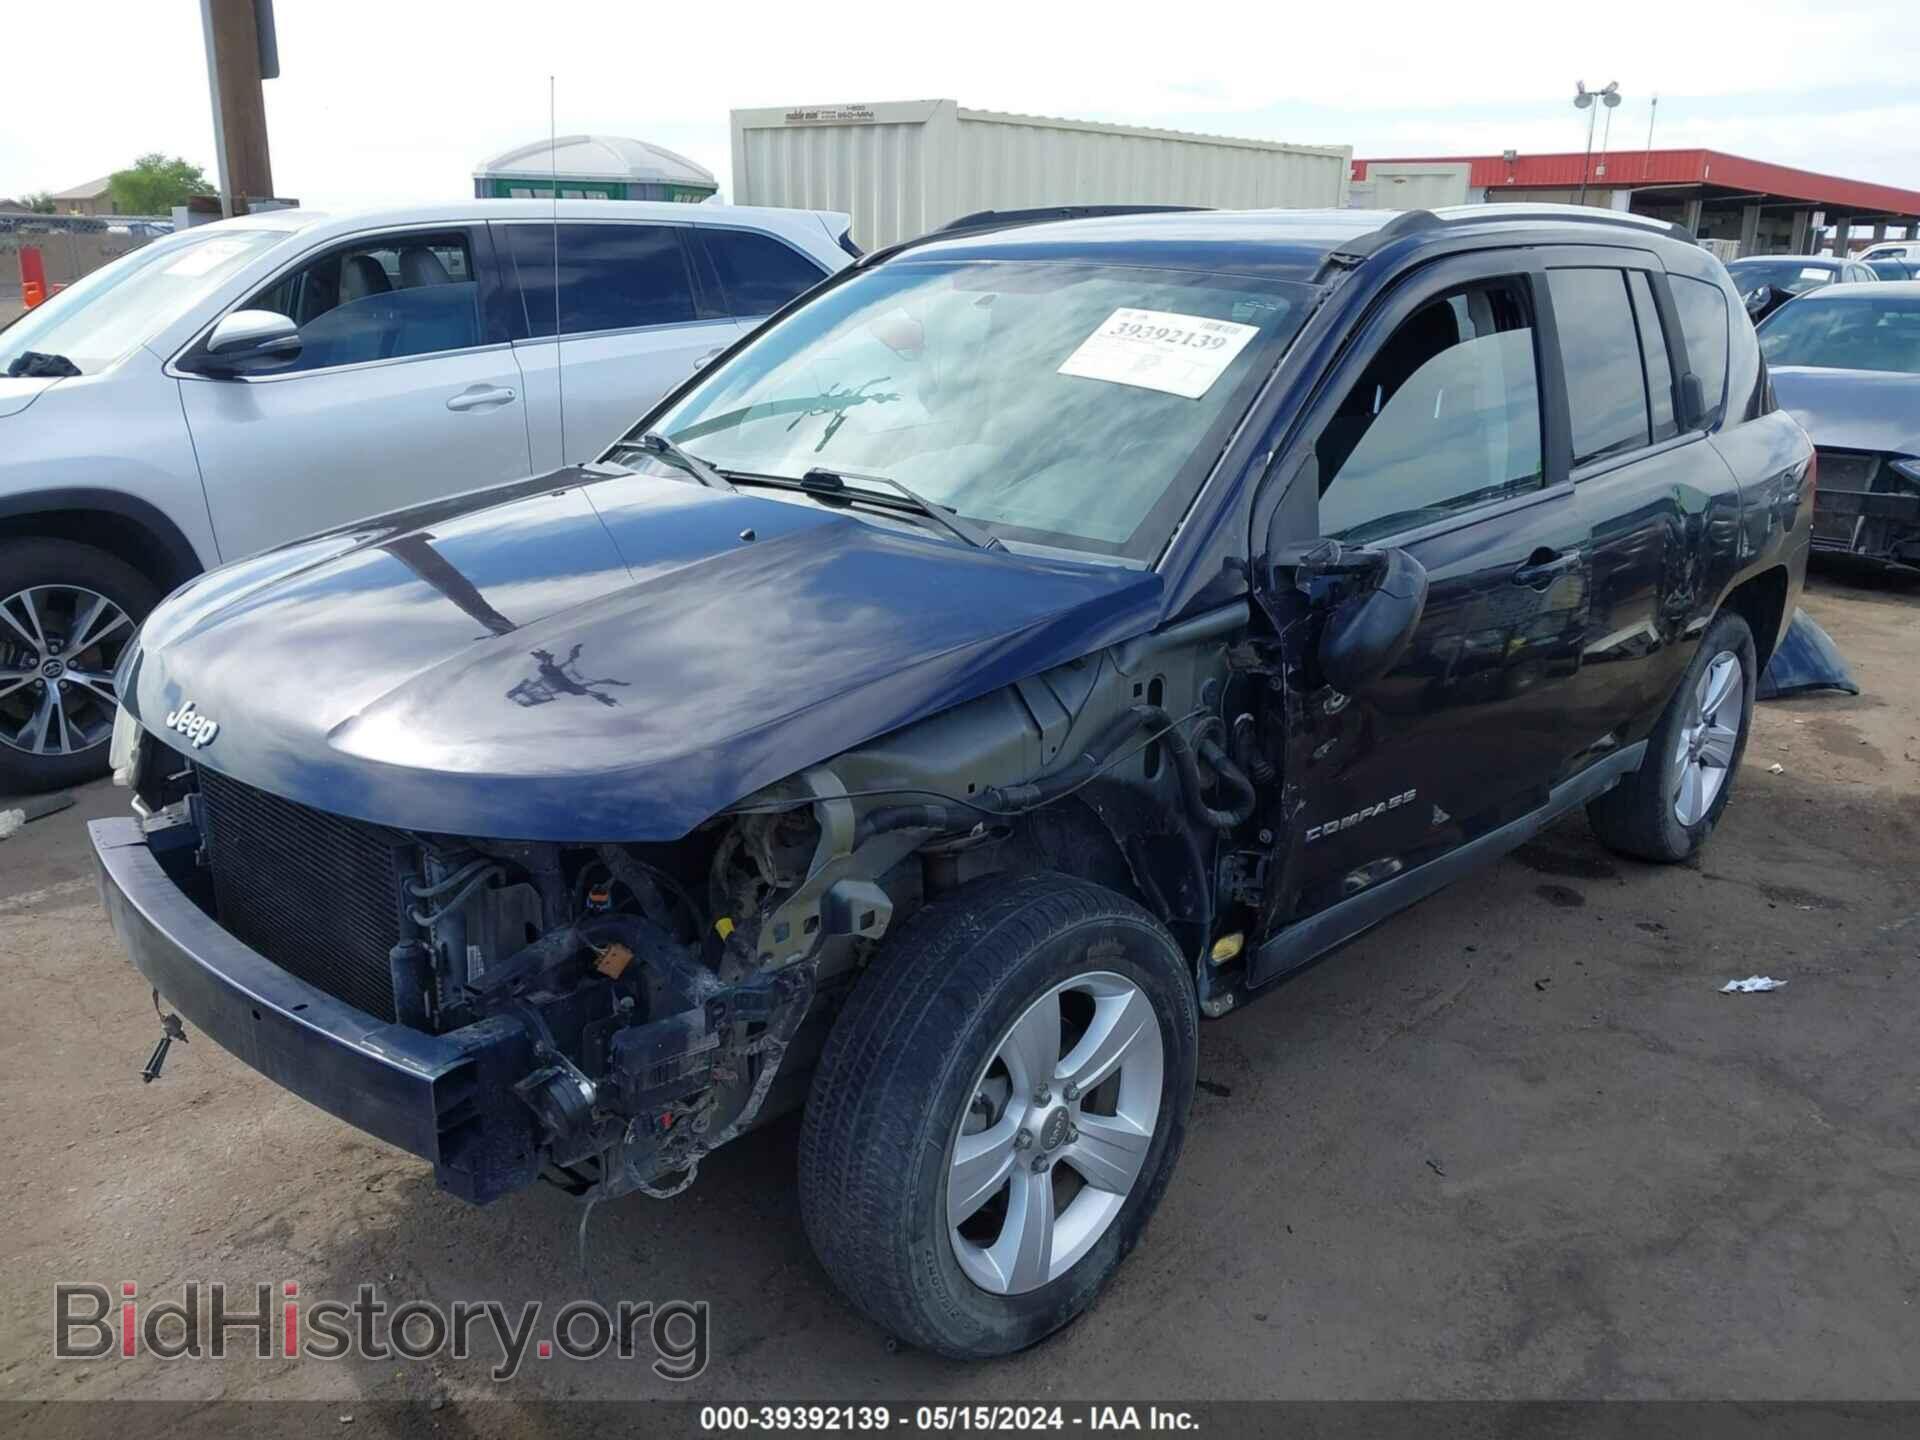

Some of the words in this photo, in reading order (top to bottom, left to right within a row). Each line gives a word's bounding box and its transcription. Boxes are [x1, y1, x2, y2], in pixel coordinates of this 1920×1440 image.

[1109, 322, 1227, 349] 39392139
[166, 700, 220, 750] Jeep
[1305, 788, 1418, 842] COMPASS
